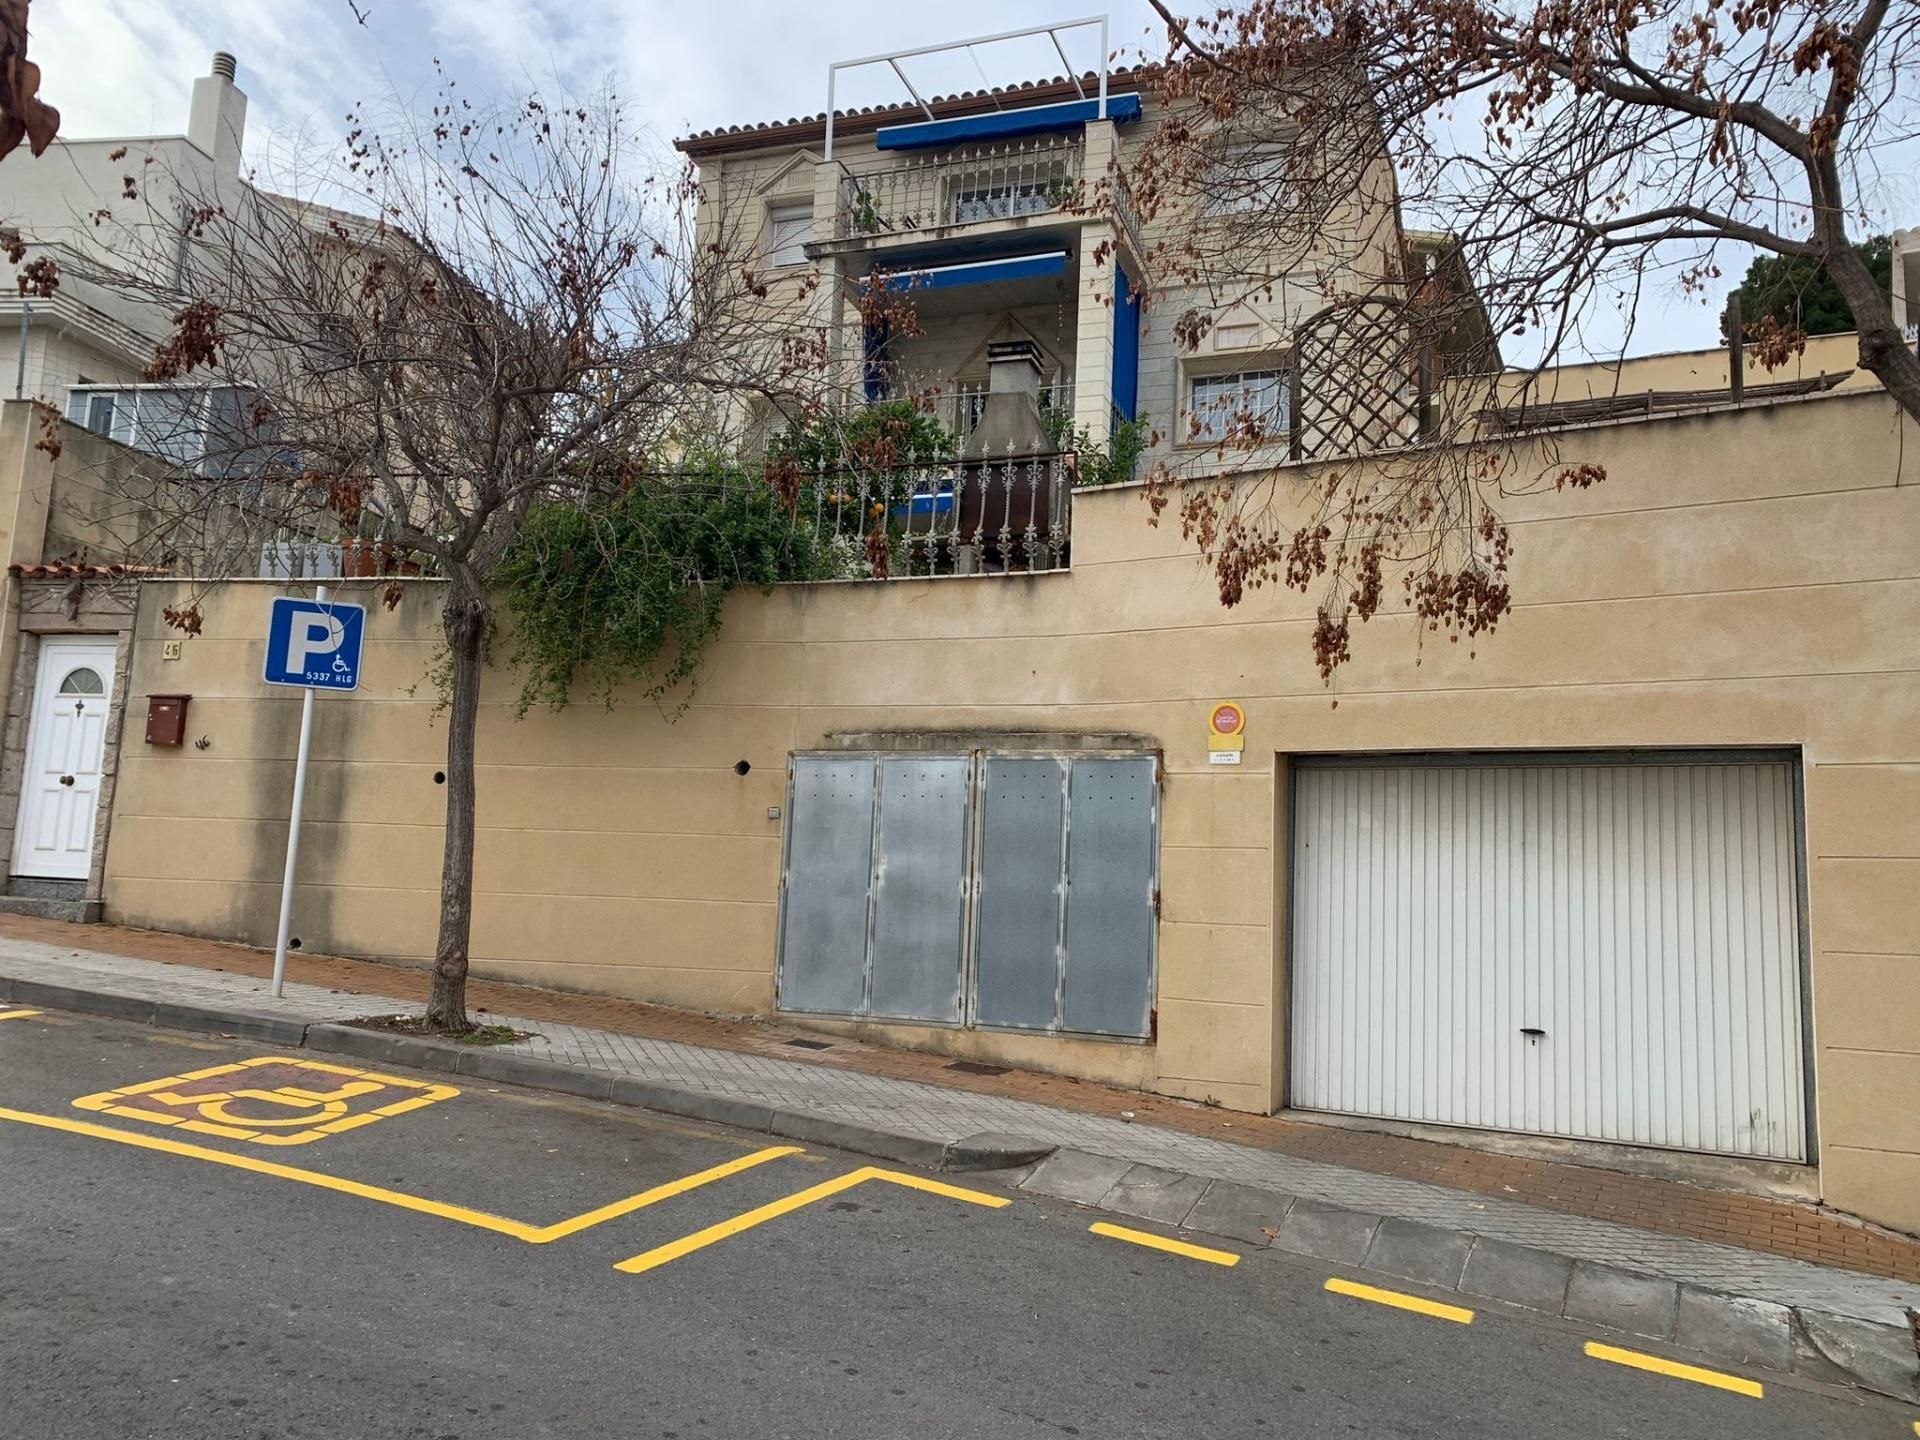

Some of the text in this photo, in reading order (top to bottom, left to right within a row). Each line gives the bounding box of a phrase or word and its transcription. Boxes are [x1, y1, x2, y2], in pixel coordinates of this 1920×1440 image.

[286, 610, 345, 675] P
[306, 671, 353, 684] 5337 HLG
[195, 734, 211, 751] 46
